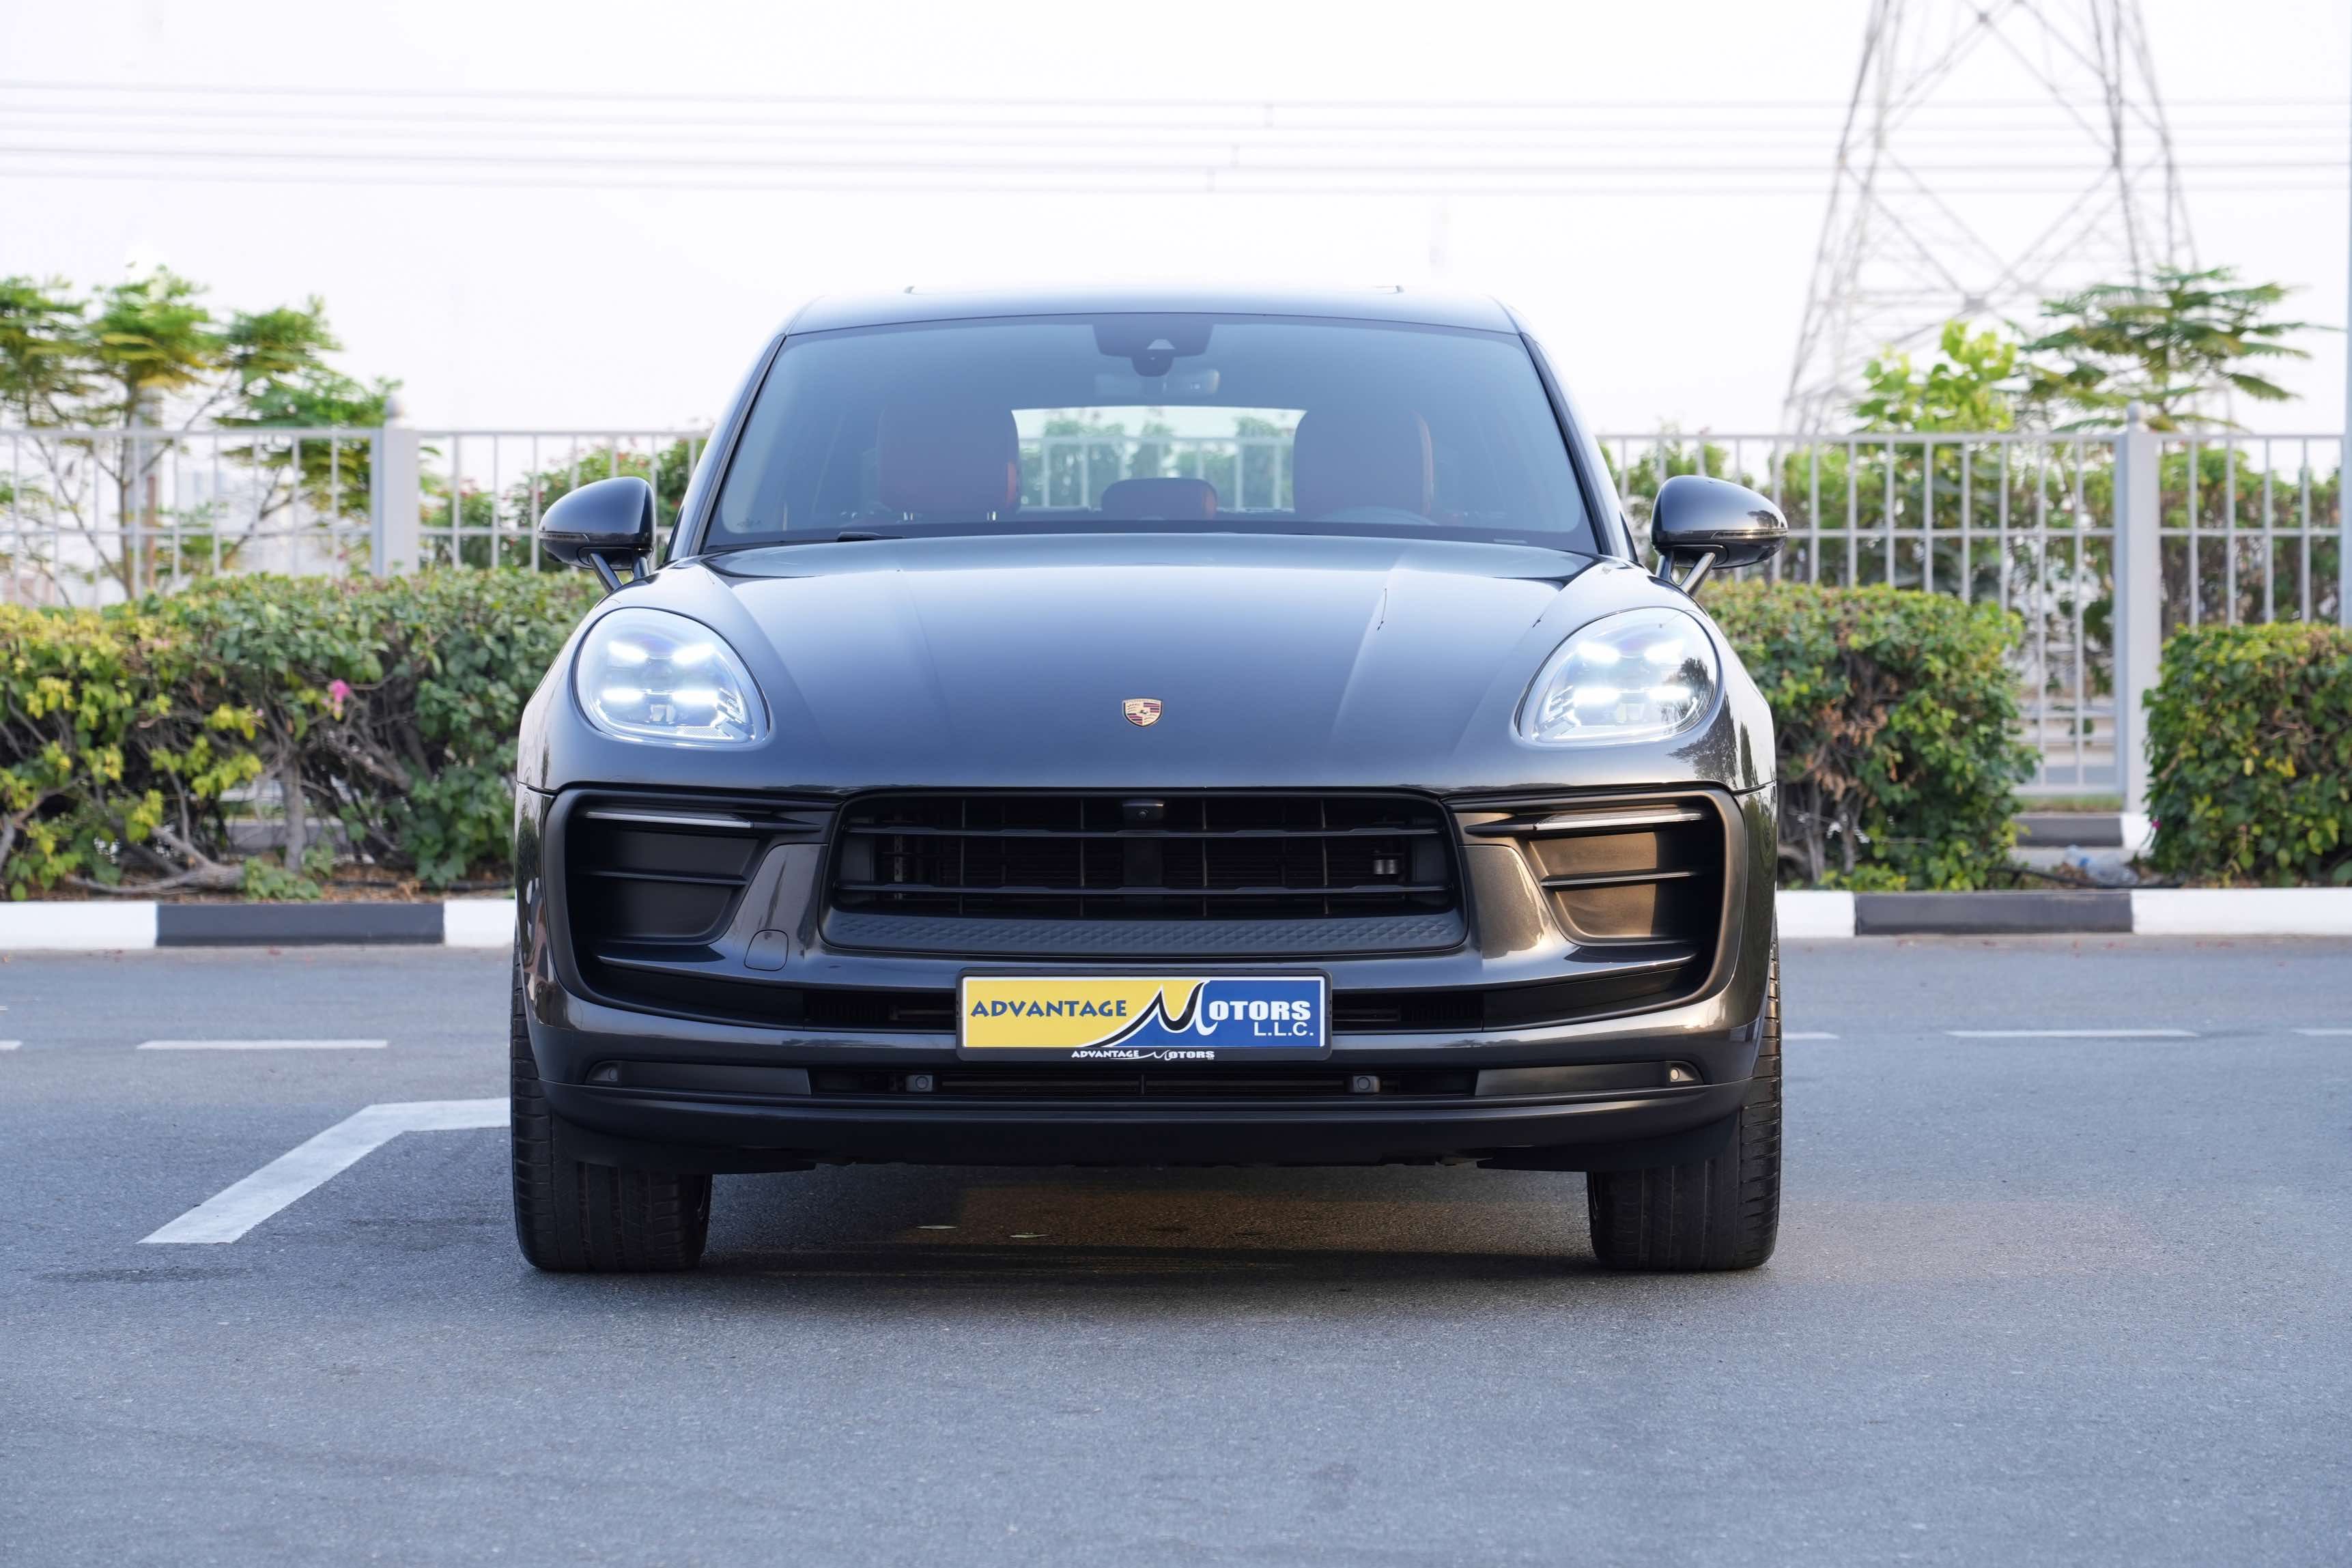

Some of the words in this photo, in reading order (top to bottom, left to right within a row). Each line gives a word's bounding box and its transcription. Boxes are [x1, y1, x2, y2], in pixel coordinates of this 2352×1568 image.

[970, 1000, 1127, 1018] ADVANTAGE
[1142, 981, 1312, 1037] MOTORS
[1253, 1021, 1314, 1036] L.L.C.
[1071, 1050, 1139, 1058] ADVANTAGE
[1150, 1049, 1215, 1061] MOTORS
